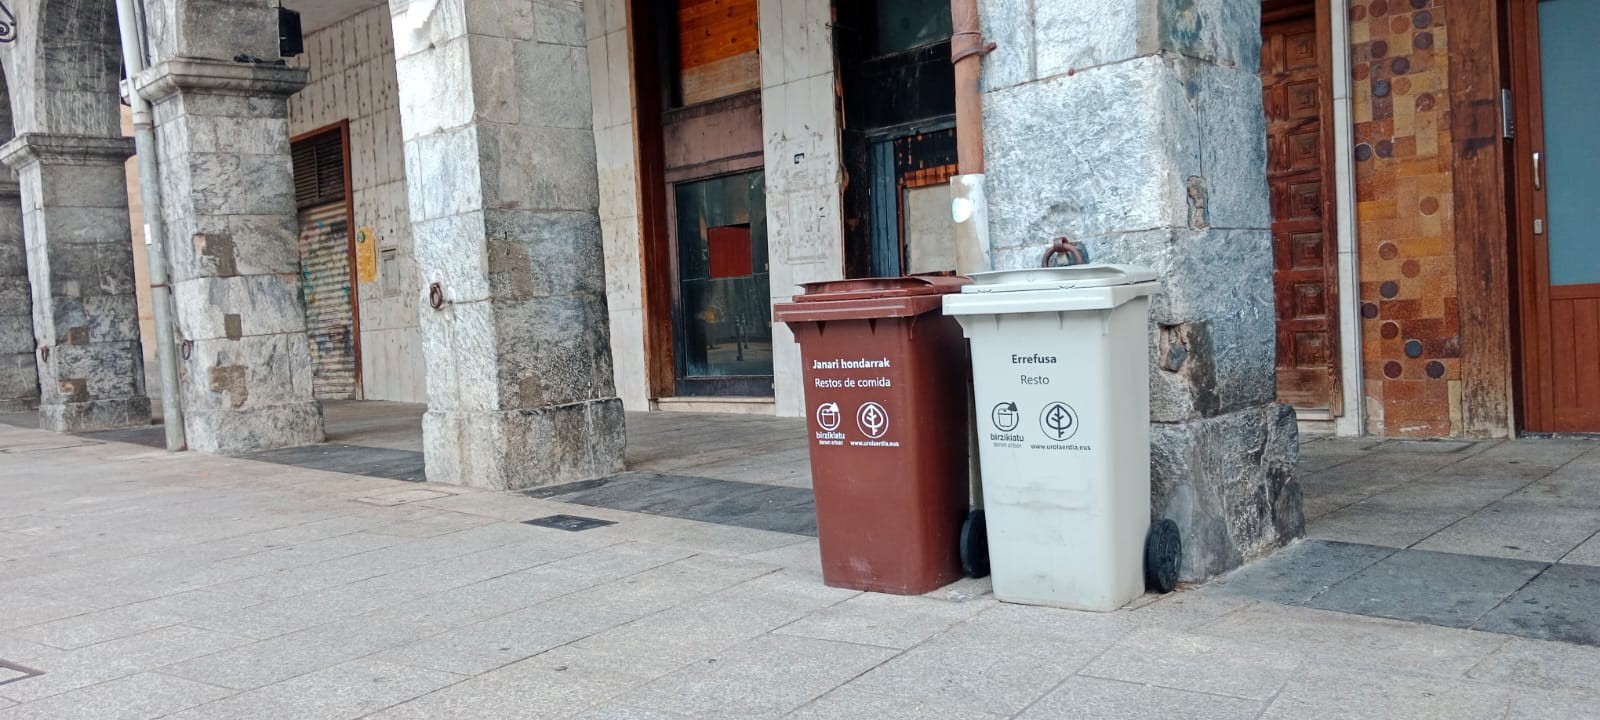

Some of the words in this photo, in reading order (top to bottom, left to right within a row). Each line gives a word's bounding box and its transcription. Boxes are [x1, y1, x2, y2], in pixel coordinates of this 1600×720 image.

[813, 359, 839, 369] Janari
[841, 357, 890, 369] hondarrak
[1011, 353, 1057, 364] Errefusa
[815, 378, 842, 388] Restos
[844, 377, 856, 387] de
[857, 377, 891, 387] comida
[1020, 374, 1050, 385] Resto
[990, 433, 1025, 442] birzikiatu
